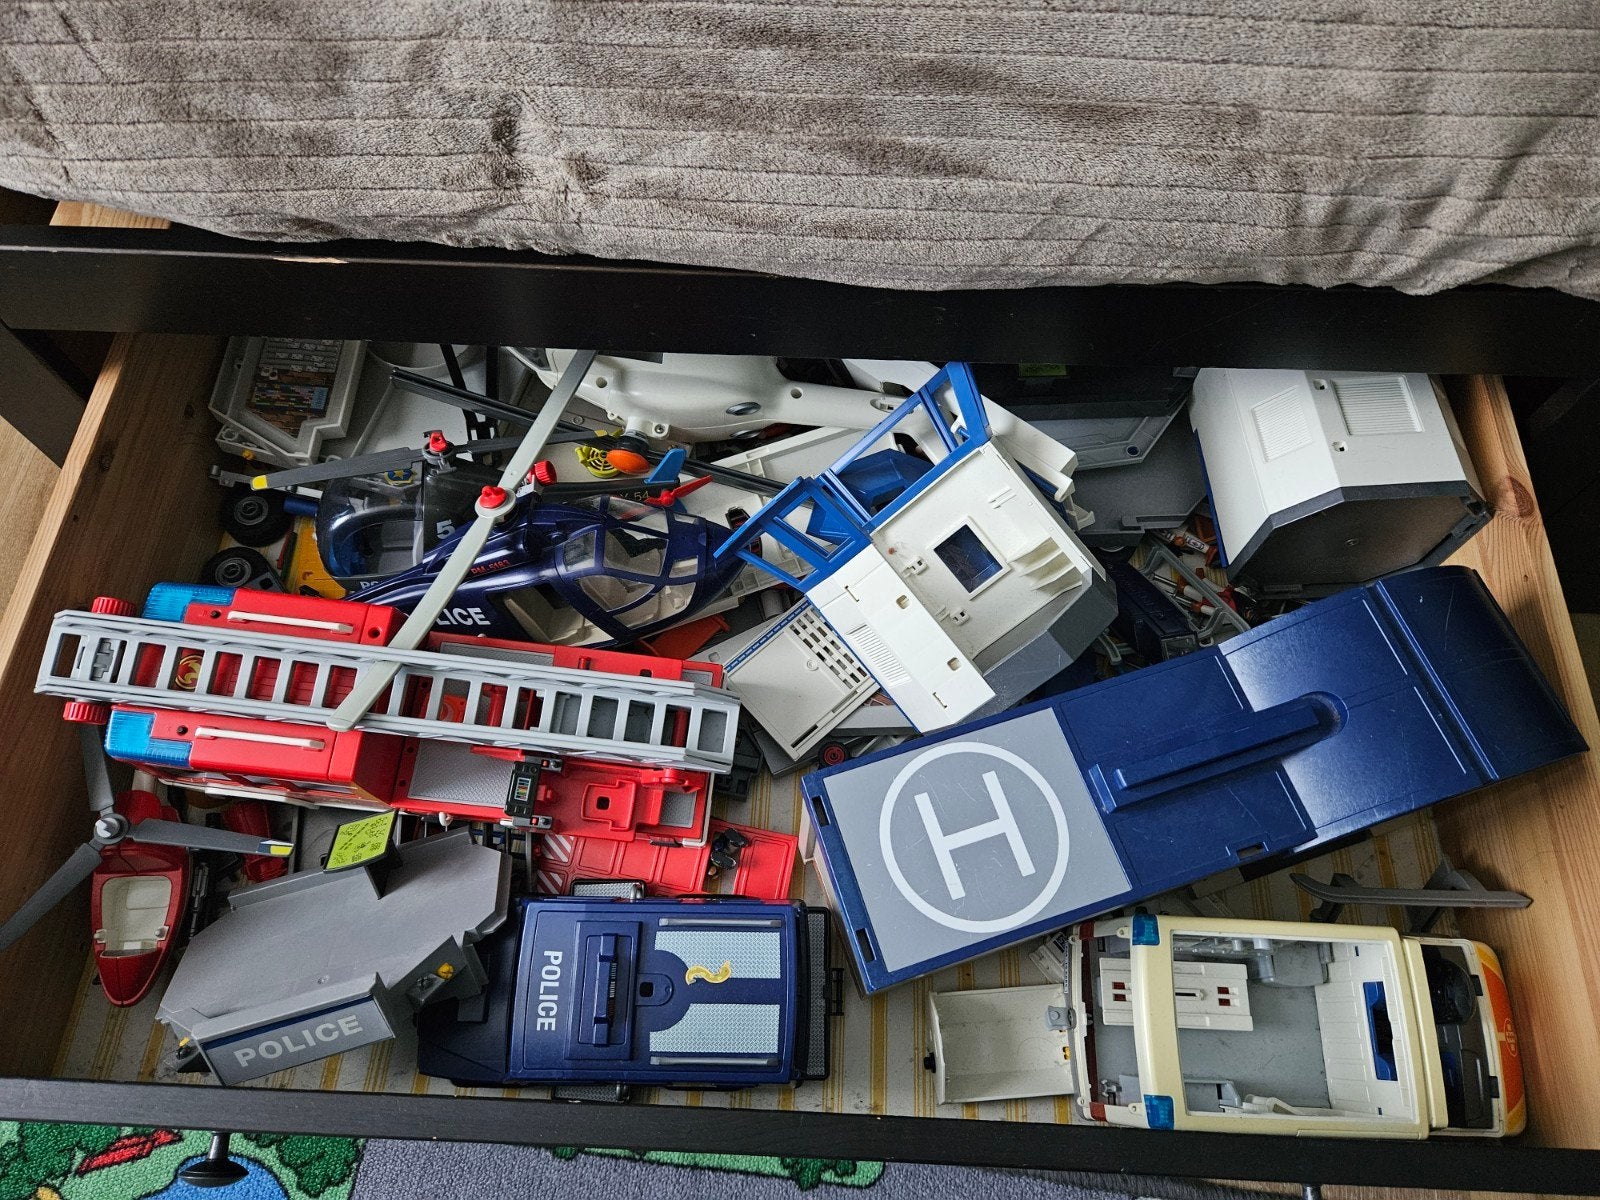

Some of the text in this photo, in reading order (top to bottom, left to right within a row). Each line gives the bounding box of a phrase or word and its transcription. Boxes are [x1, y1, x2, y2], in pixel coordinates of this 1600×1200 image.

[436, 519, 456, 539] 5
[436, 607, 491, 626] LICE
[914, 770, 1037, 900] H
[535, 950, 563, 1033] POLICE
[233, 1014, 364, 1069] POLICE
